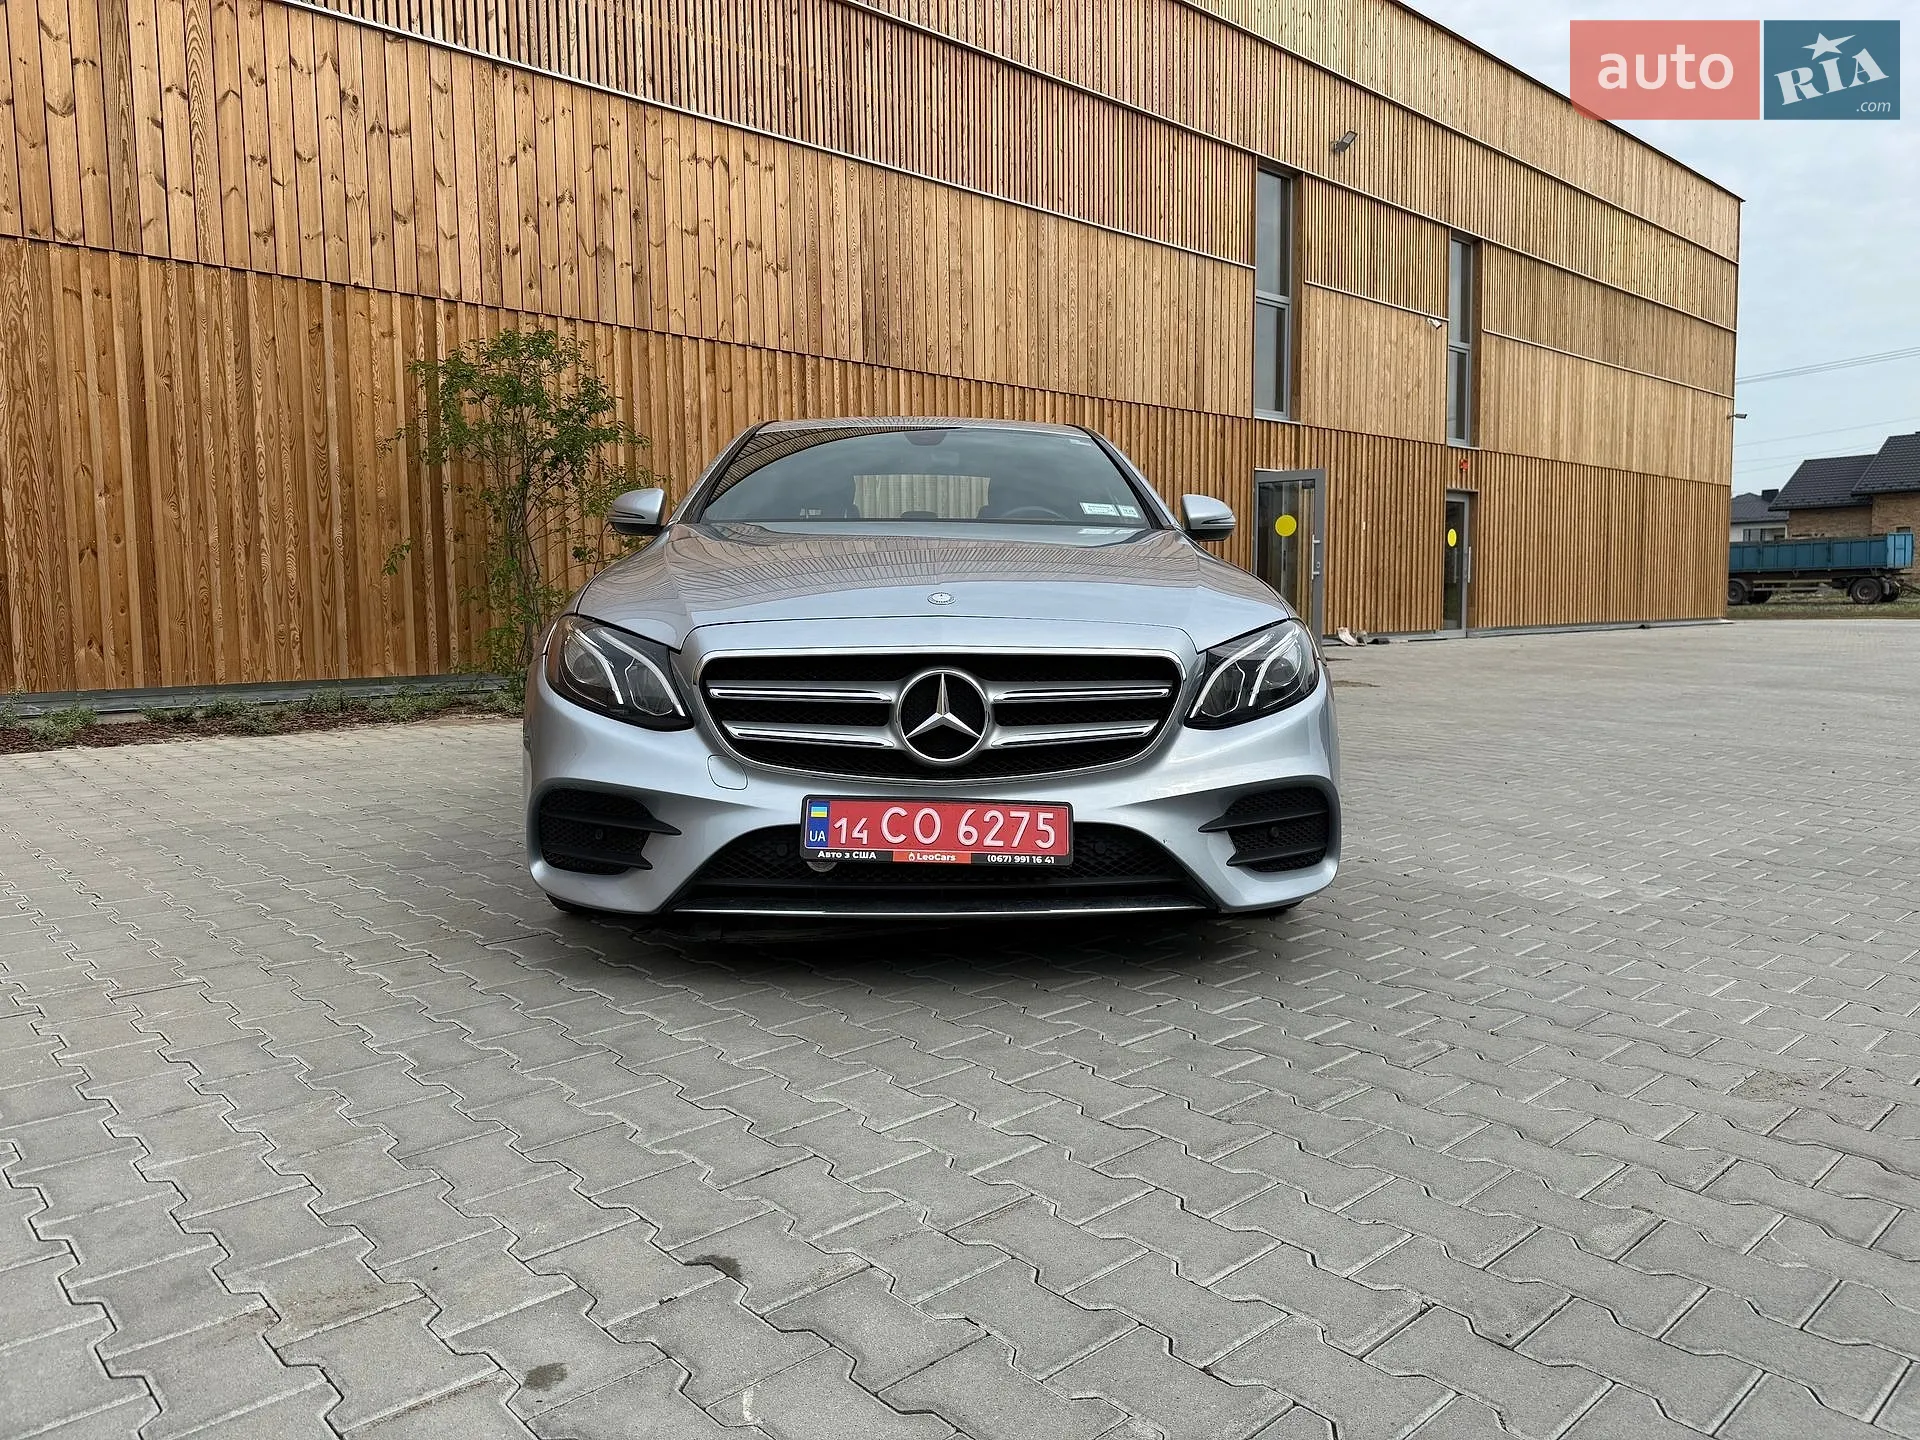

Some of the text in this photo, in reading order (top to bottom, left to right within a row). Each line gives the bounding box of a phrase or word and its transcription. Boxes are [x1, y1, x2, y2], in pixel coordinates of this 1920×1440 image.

[833, 806, 1056, 849] 14 CO 6275
[809, 830, 826, 842] UA
[817, 850, 877, 860] Авто з США
[916, 852, 956, 862] LeoCars
[987, 854, 1055, 864] (067) 991 16 41
